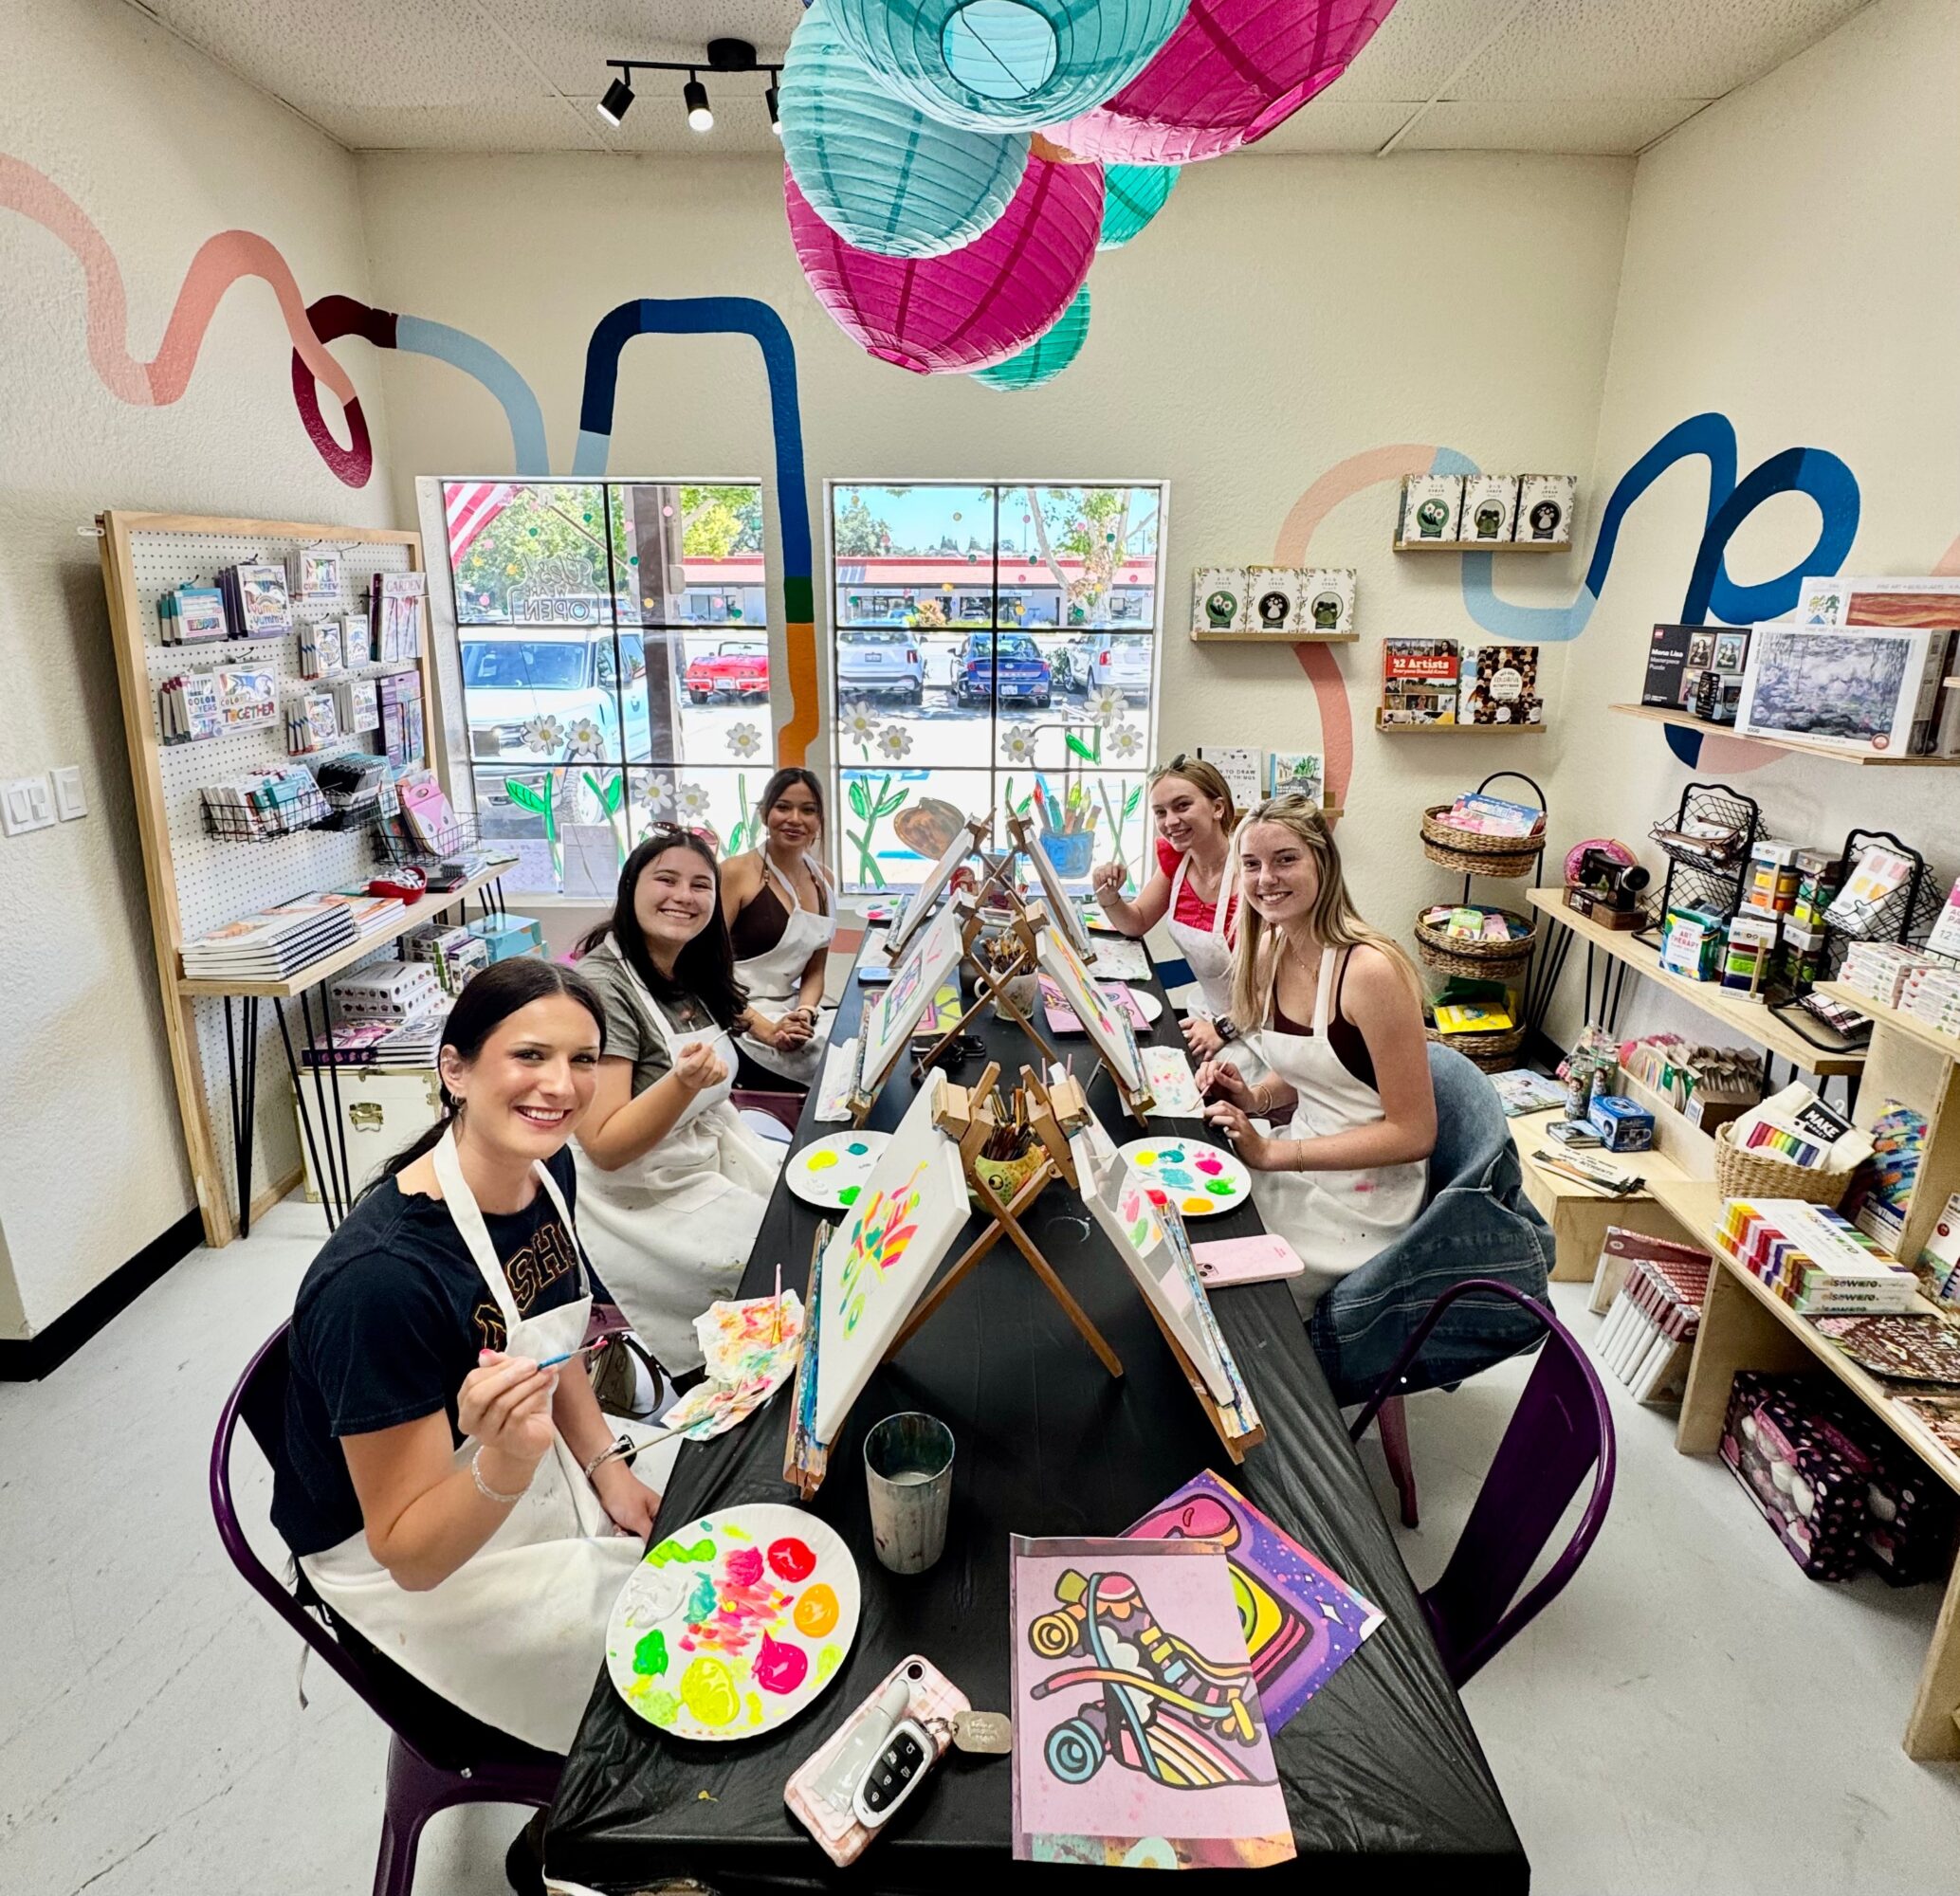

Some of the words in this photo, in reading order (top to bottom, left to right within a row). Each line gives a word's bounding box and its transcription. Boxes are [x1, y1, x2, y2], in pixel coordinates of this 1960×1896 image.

[1651, 648, 1669, 657] Mona
[1670, 649, 1684, 658] Lisa
[1393, 658, 1406, 667] 42
[1408, 658, 1449, 668] Artists
[188, 695, 216, 706] COLOR
[222, 702, 275, 723] TOGETHER
[1939, 930, 1952, 940] 12
[1671, 935, 1699, 949] THERAPY
[1804, 1110, 1840, 1139] MAKE
